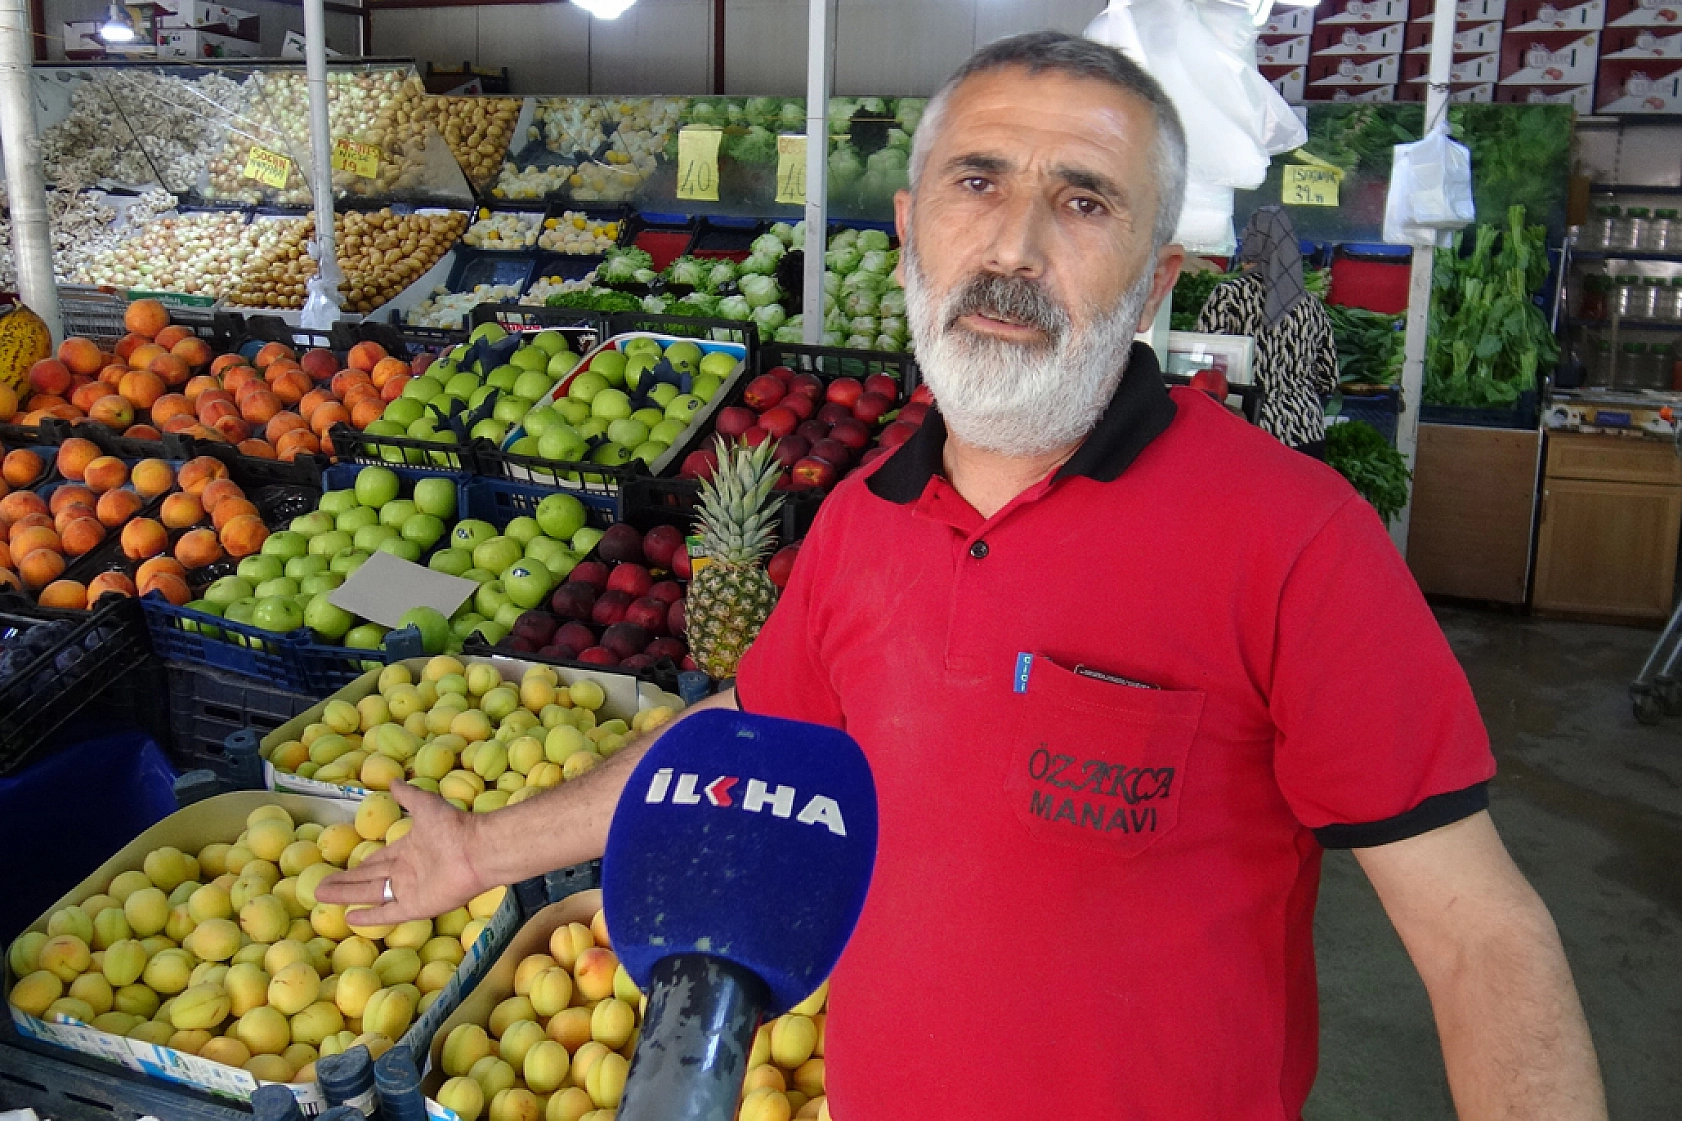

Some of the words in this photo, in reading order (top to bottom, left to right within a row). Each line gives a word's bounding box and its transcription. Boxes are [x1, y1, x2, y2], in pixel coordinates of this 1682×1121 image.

[680, 159, 711, 195] 40
[1028, 742, 1175, 806] ÖZAKÇA
[645, 768, 847, 837] İLKHA
[1029, 789, 1157, 834] MANAVI
